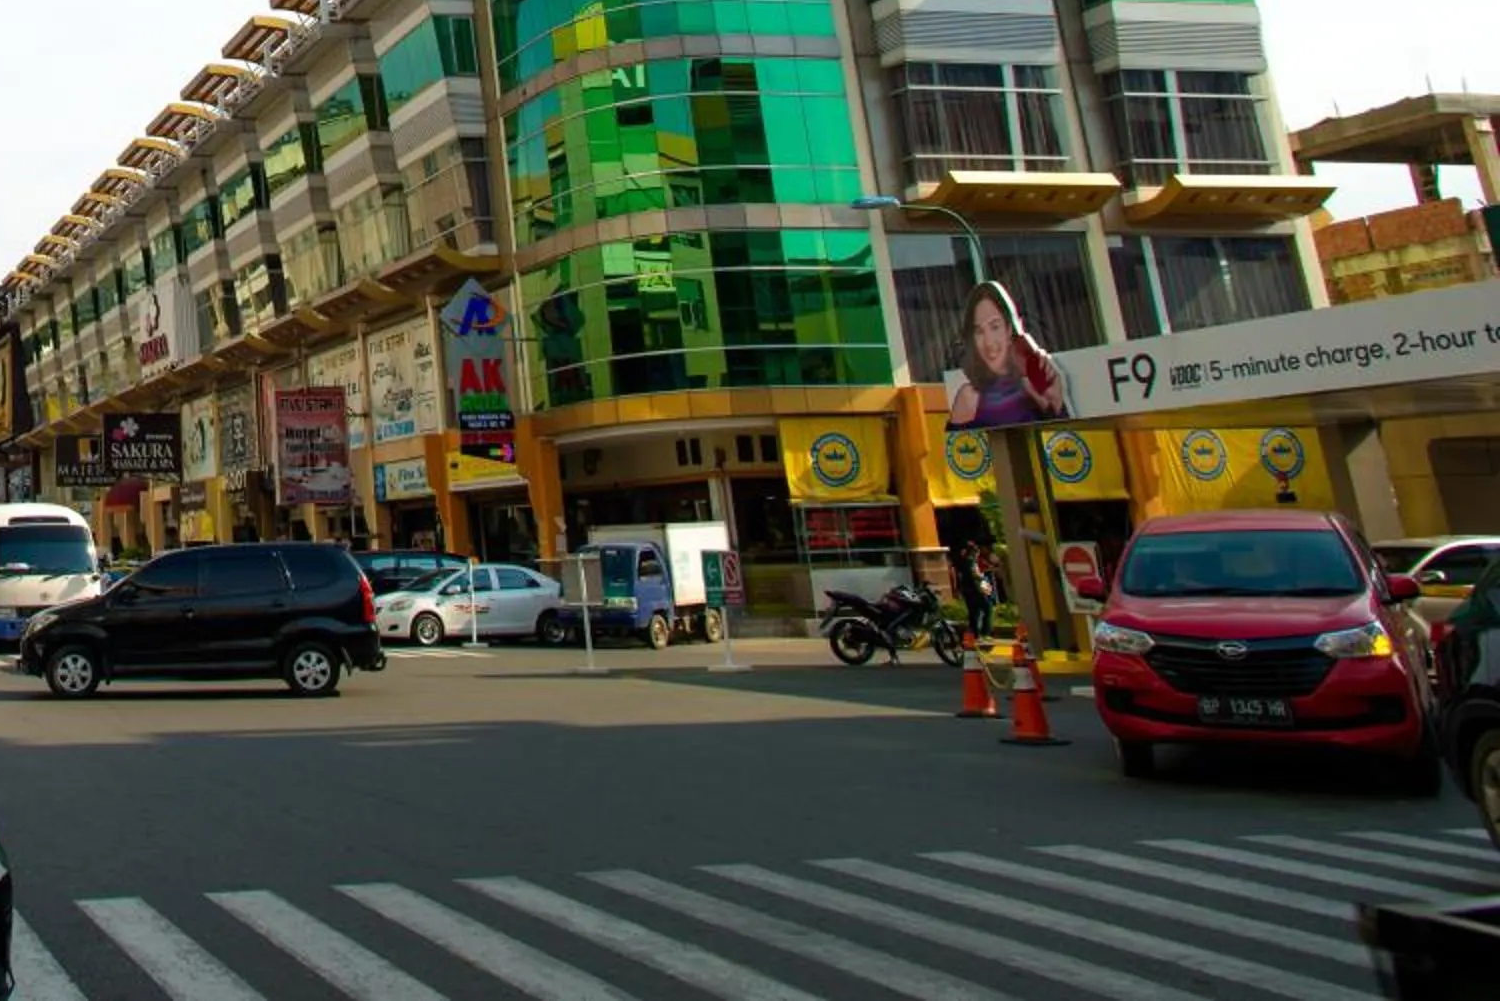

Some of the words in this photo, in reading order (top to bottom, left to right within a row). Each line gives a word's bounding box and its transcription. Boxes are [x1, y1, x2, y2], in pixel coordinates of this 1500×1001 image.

[460, 359, 507, 393] AK
[1106, 352, 1158, 404] F9
[1209, 353, 1300, 382] 5-minute
[1304, 342, 1392, 369] charge,
[1393, 328, 1477, 357] 2-hour
[110, 442, 174, 459] SAKURA
